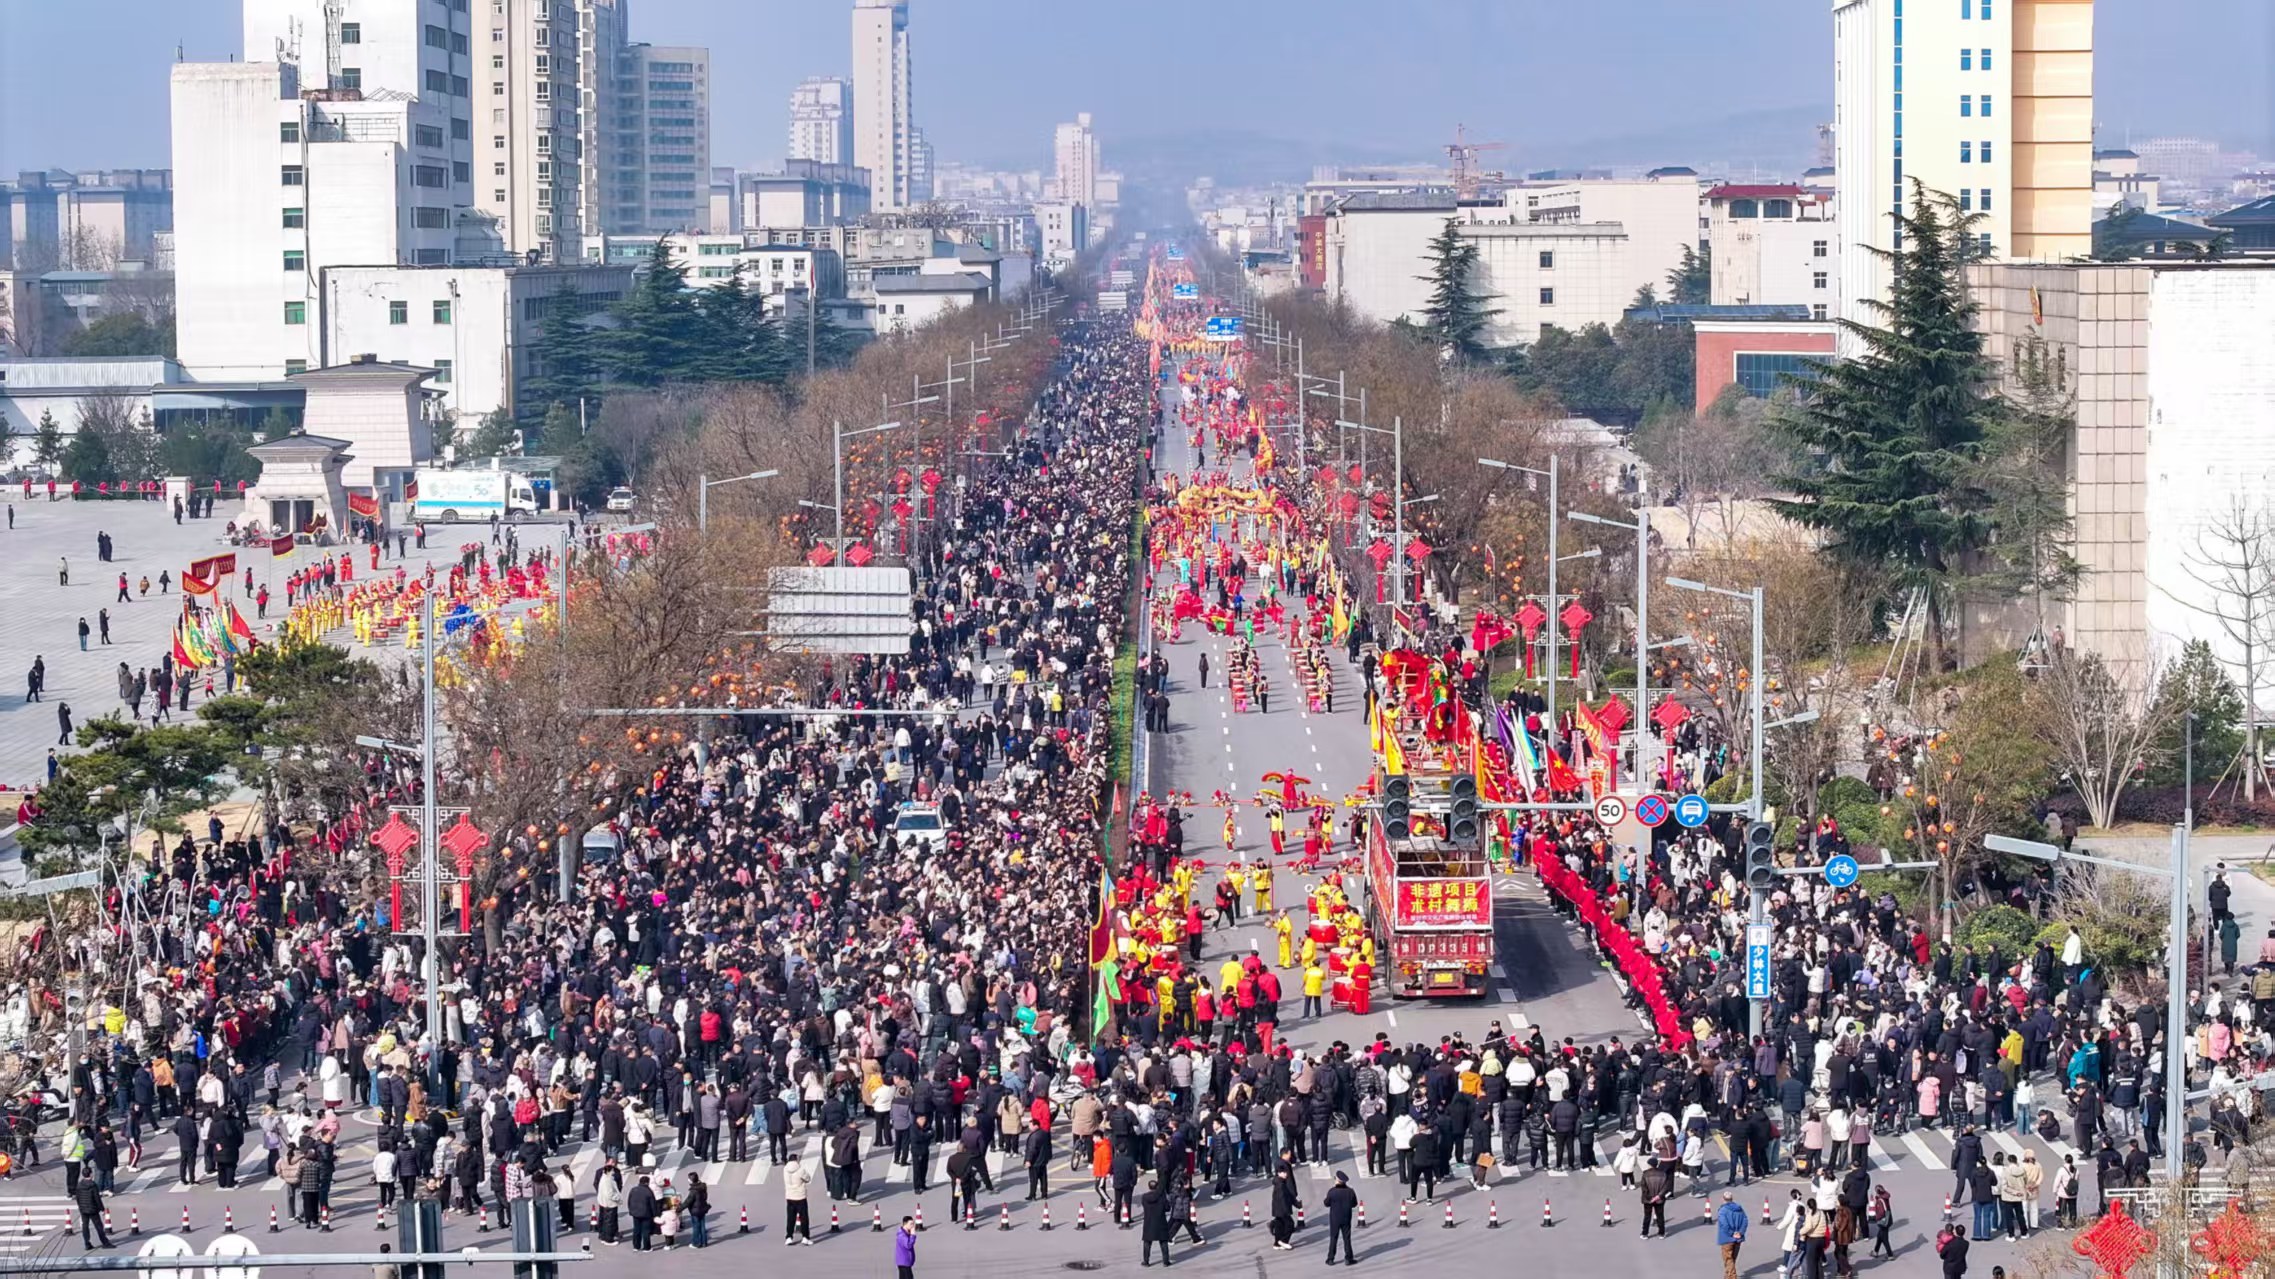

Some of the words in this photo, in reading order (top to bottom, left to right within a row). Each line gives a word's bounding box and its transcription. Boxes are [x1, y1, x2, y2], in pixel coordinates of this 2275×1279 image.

[1600, 804, 1620, 817] 50
[1410, 882, 1477, 898] 非遗项目
[1753, 946, 1765, 995] 少林大道
